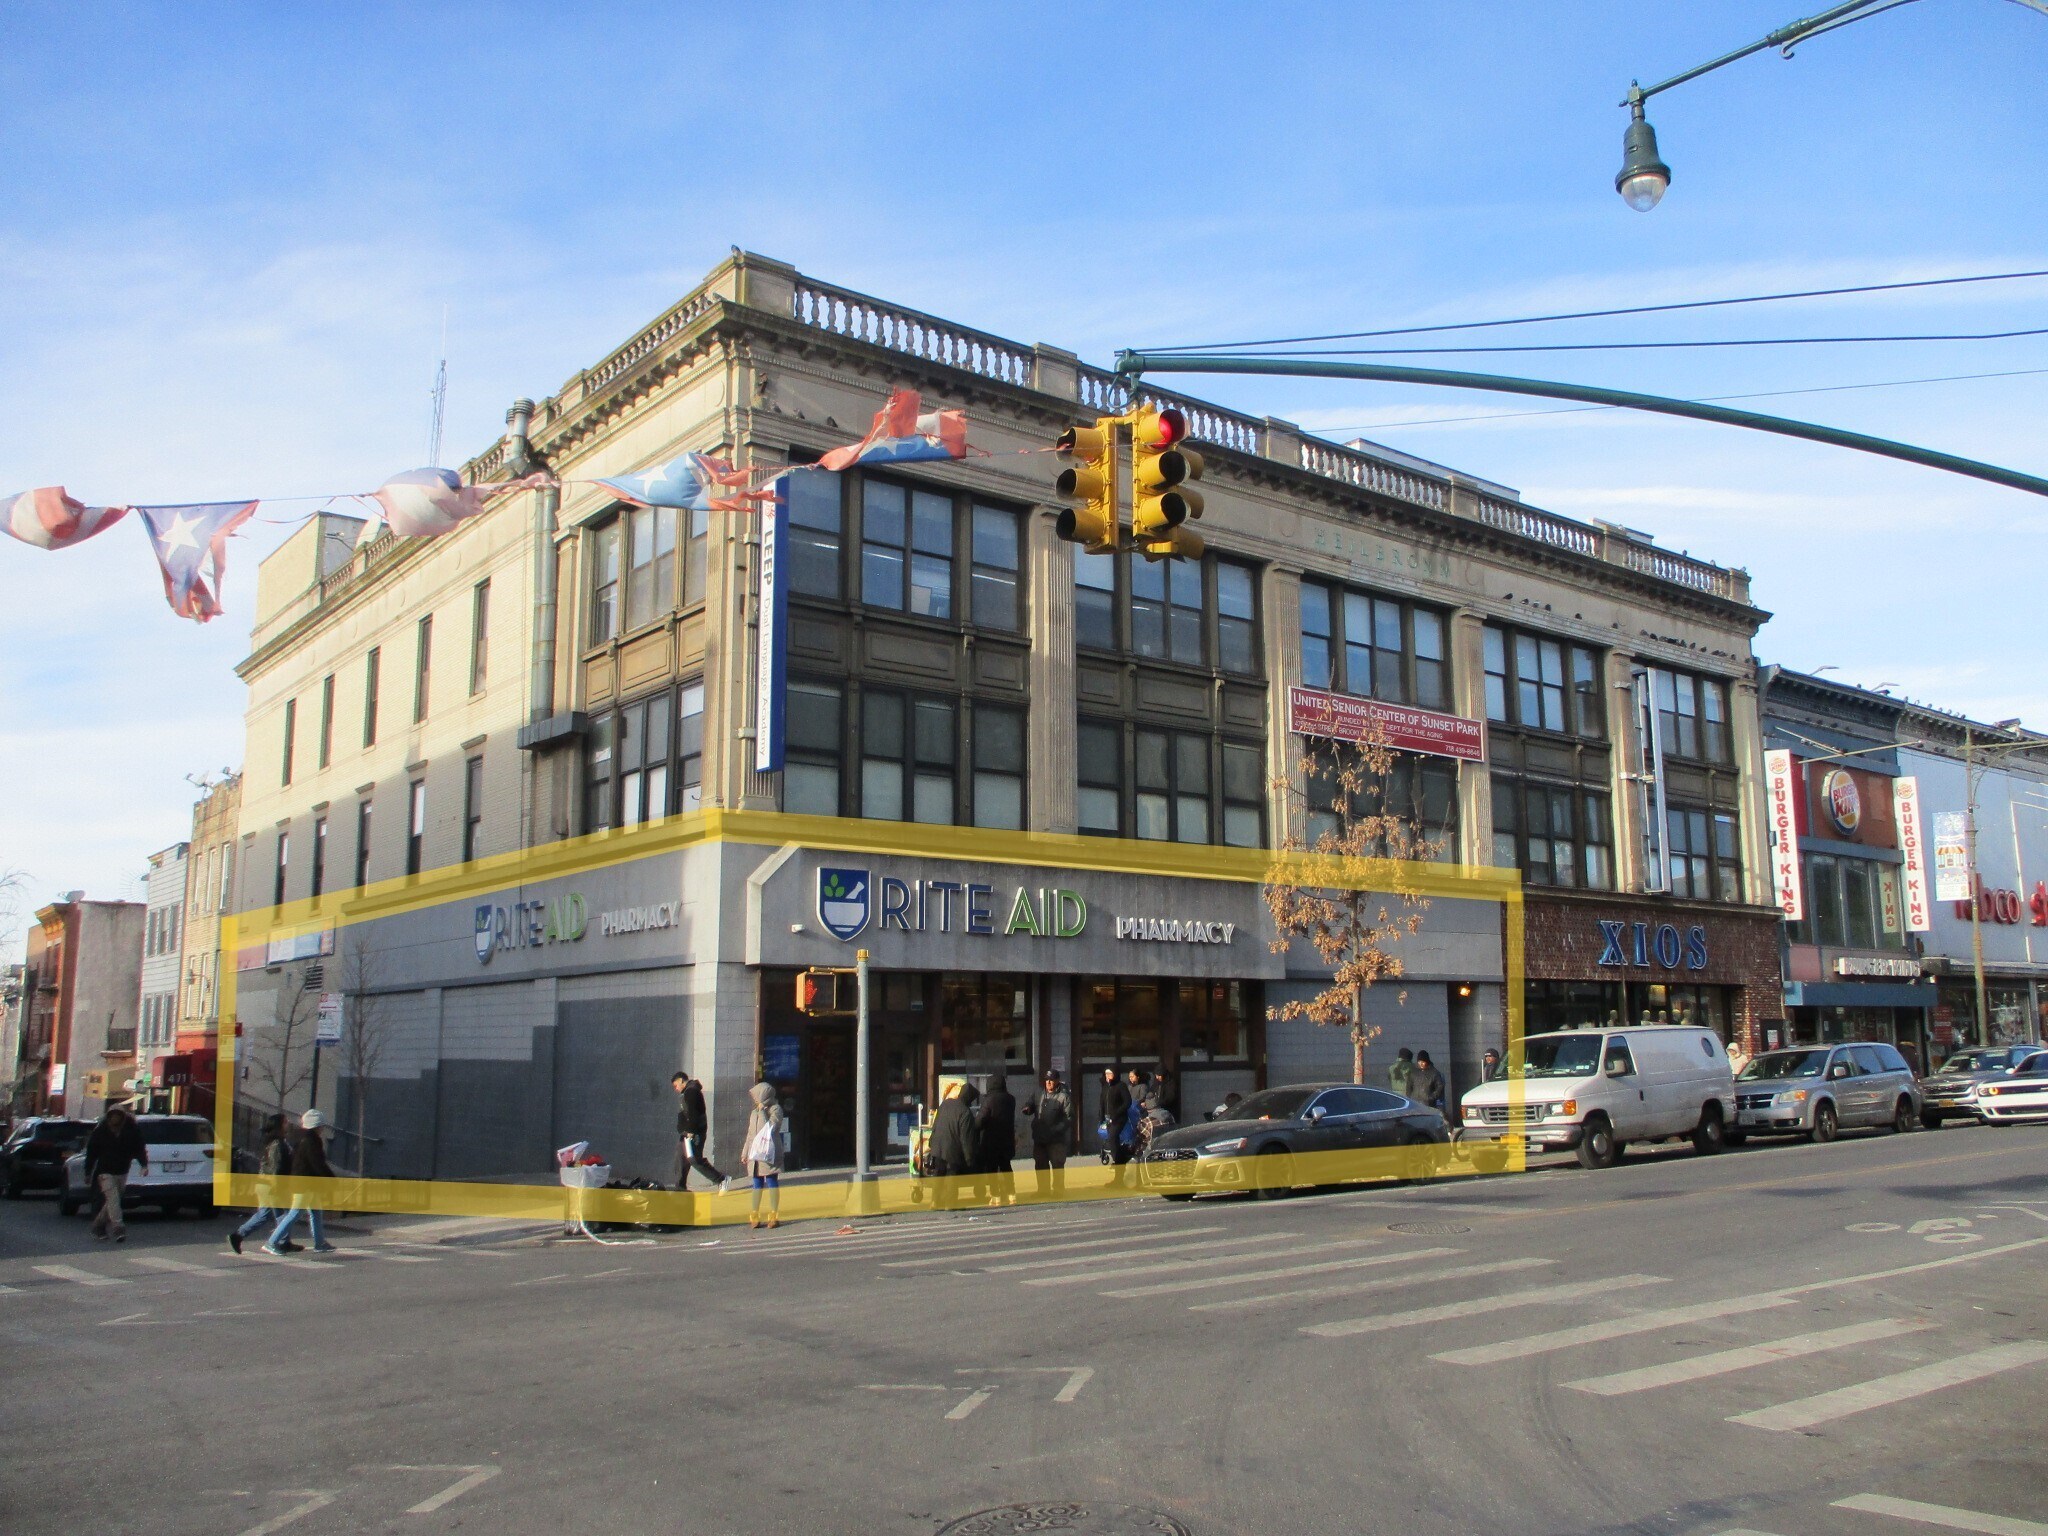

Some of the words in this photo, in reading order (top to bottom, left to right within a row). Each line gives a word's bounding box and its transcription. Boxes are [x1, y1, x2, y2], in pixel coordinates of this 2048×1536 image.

[763, 530, 773, 586] LEEP
[763, 596, 771, 628] Dual
[760, 632, 769, 691] Language
[759, 698, 769, 755] Academy
[1408, 714, 1419, 726] OF
[1427, 731, 1443, 739] AGING
[1774, 777, 1790, 854] BURGER
[1901, 802, 1918, 871] BURGER
[880, 877, 994, 934] RITE
[1004, 886, 1087, 937] AID
[1116, 916, 1236, 944] PHARMACY
[1780, 863, 1795, 914] KING
[1908, 880, 1923, 925] KING
[495, 900, 545, 950] RITE
[546, 891, 589, 943] AID
[601, 900, 682, 936] PHARMACY
[1597, 920, 1707, 969] XIOS
